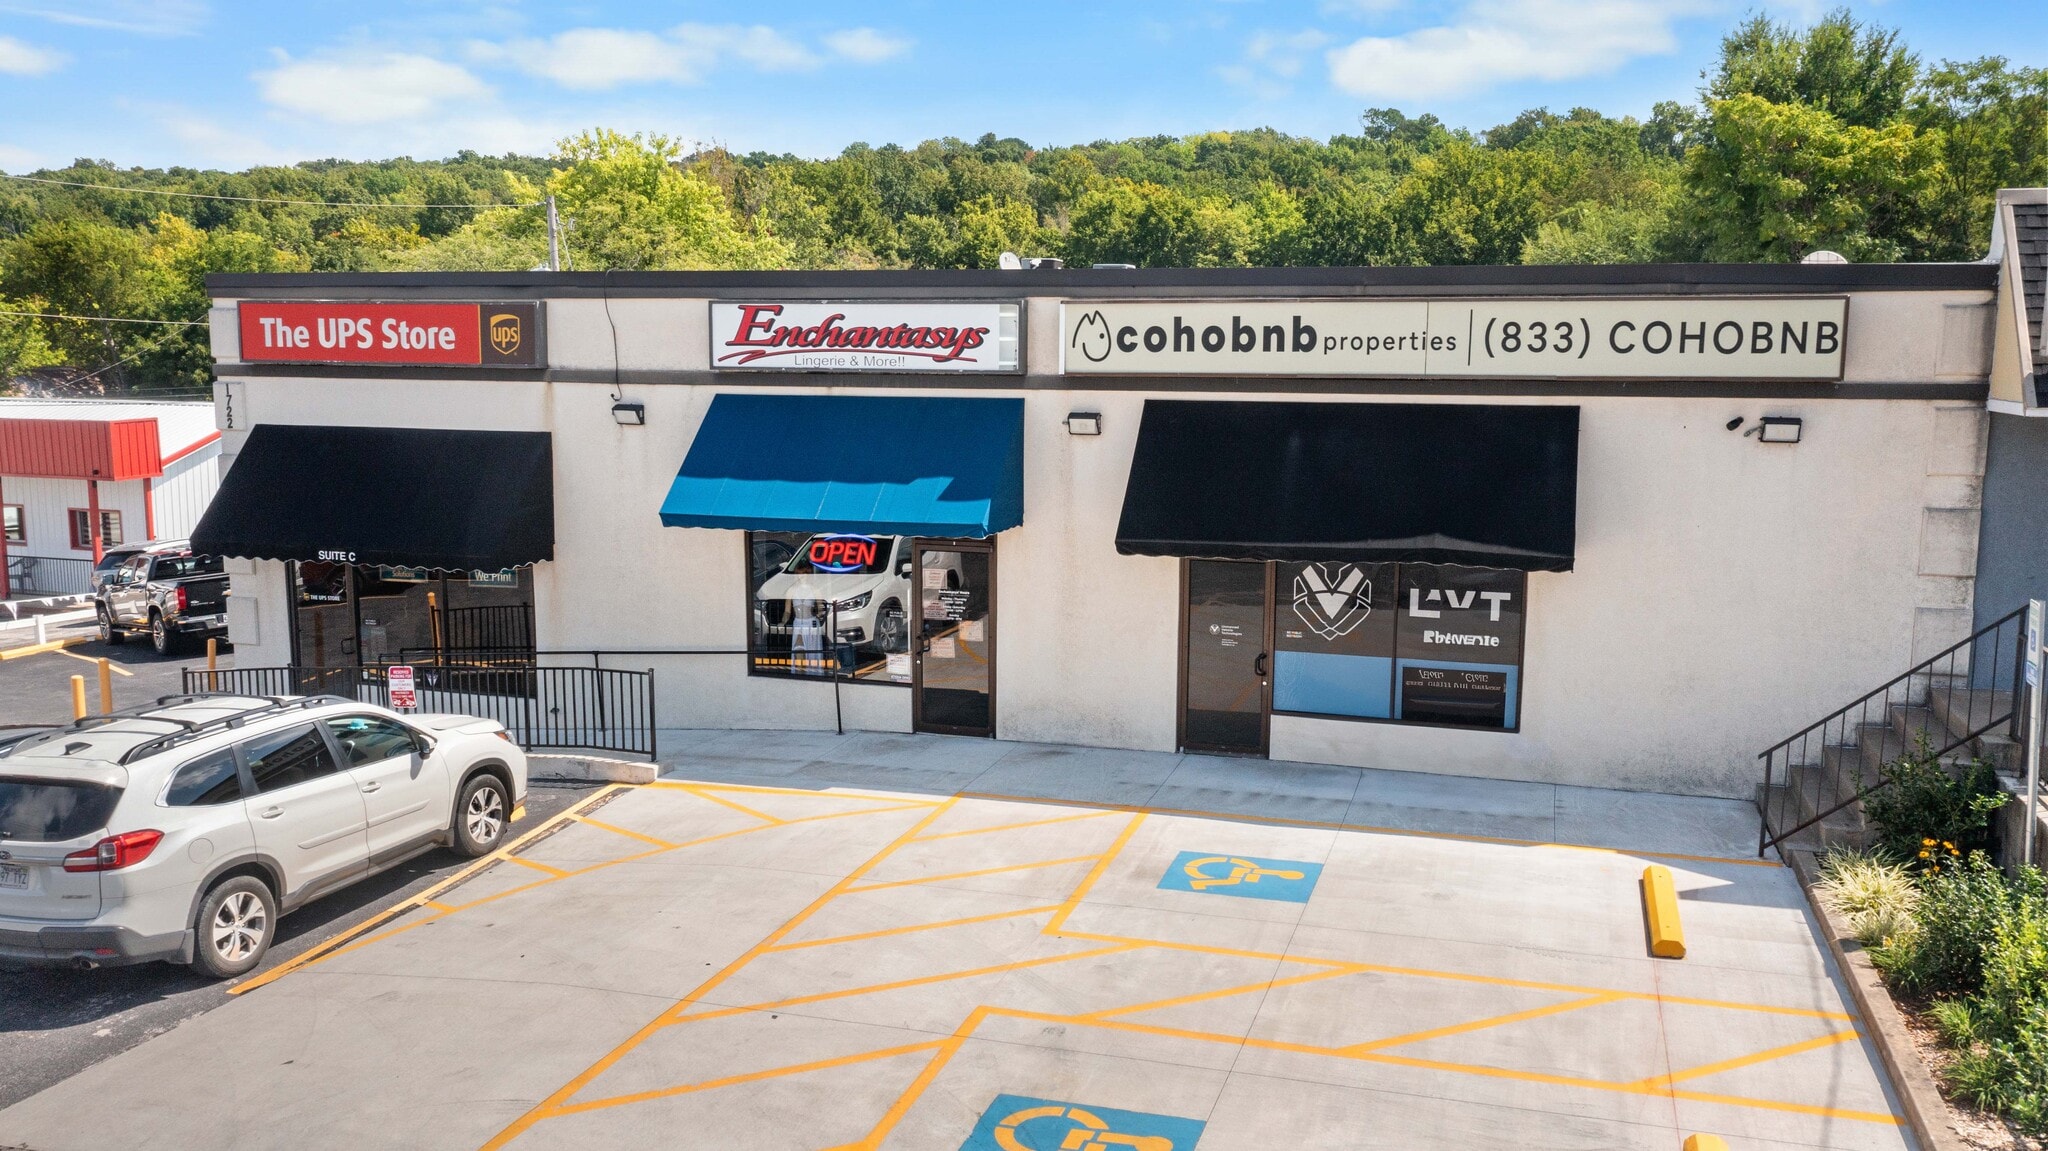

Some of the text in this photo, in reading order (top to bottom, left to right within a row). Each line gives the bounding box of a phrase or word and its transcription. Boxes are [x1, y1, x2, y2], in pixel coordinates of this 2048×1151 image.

[259, 317, 456, 350] The UPS Store
[493, 326, 518, 348] ups
[725, 304, 991, 361] Enchantasys
[1116, 315, 1457, 356] cohobnb properties
[1484, 317, 1840, 359] (833) COHOBNB
[794, 355, 906, 369] Lingerie & More!!
[225, 383, 234, 429] 1722
[318, 550, 357, 562] SUITE C
[809, 540, 877, 566] OPEN
